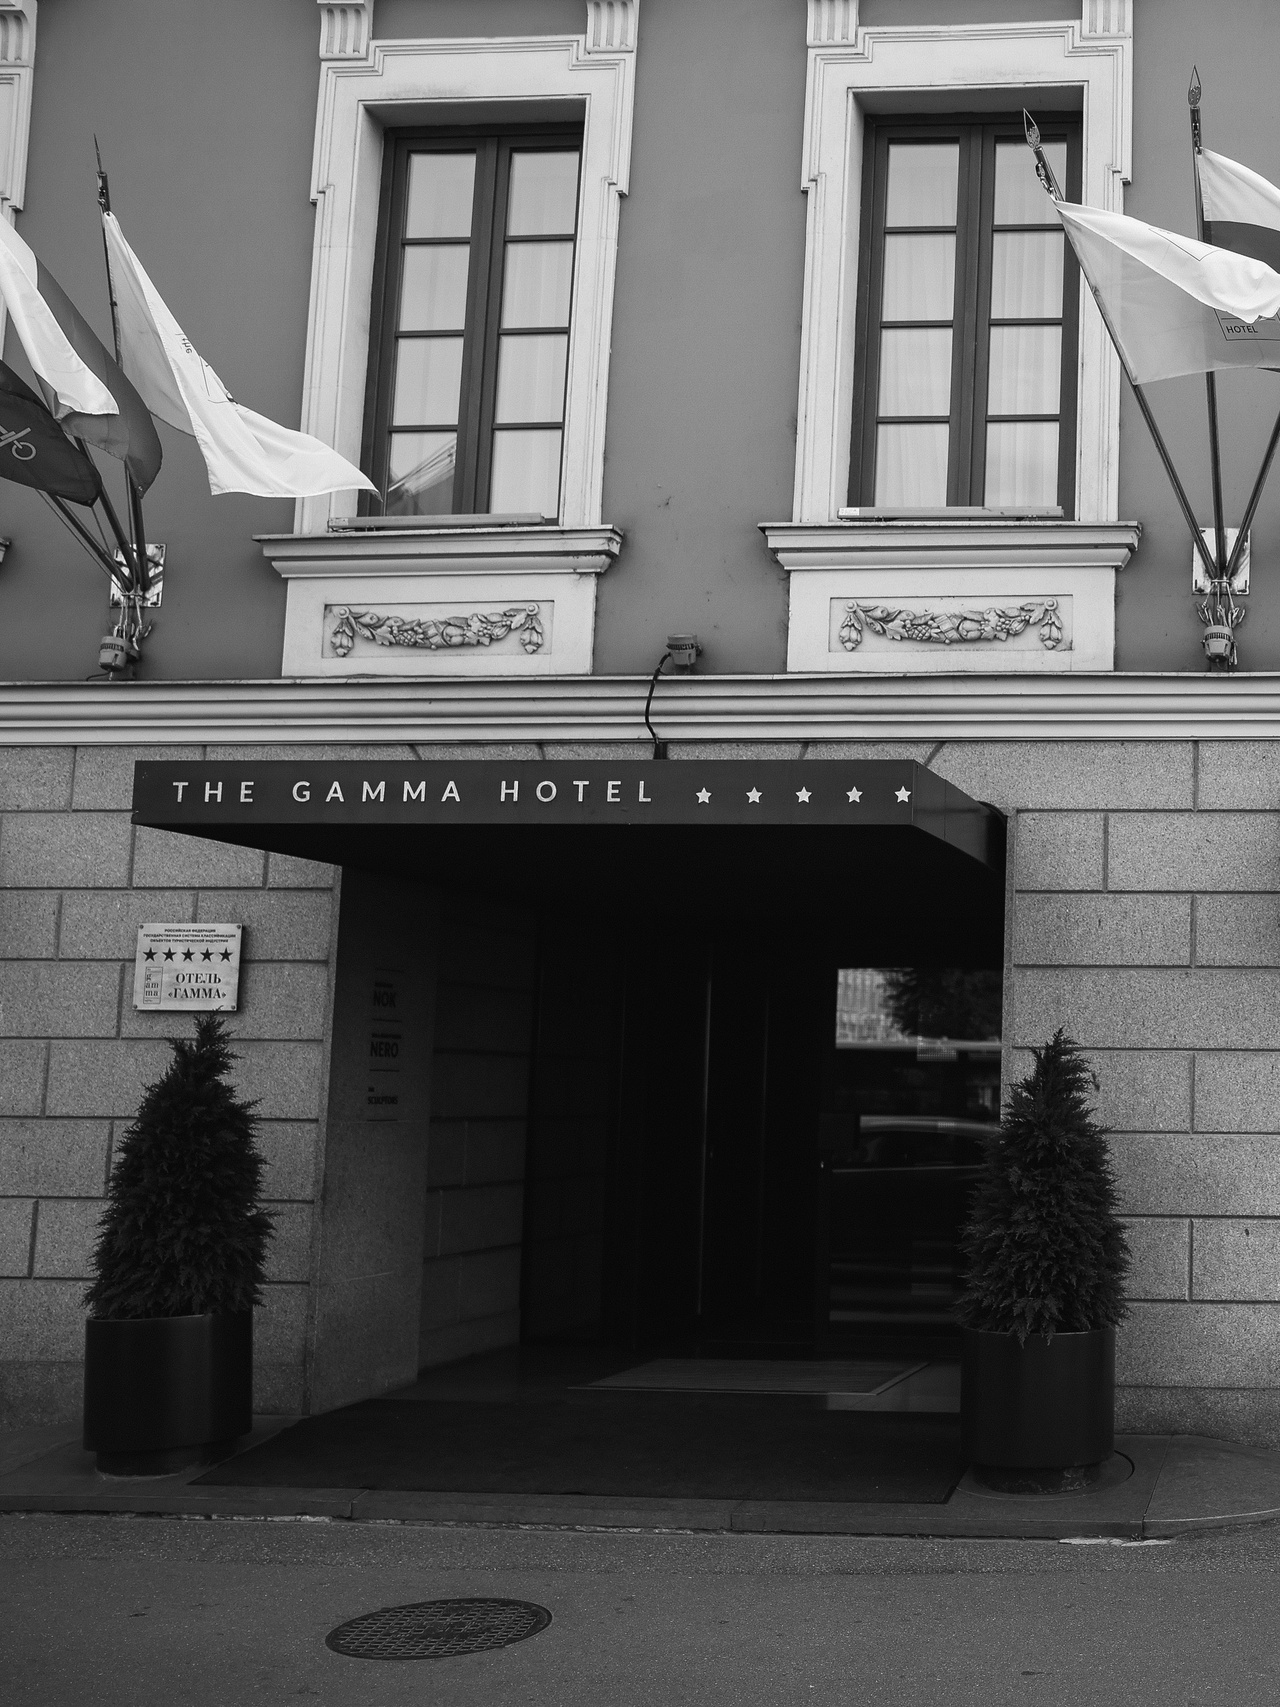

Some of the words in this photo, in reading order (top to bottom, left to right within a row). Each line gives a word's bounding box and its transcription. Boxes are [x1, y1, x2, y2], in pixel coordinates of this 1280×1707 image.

[1226, 325, 1258, 333] HOTEL
[172, 781, 255, 803] THE
[292, 780, 461, 803] GAMMA
[500, 780, 652, 803] HOTEL
[175, 973, 222, 984] ОТЕЛЬ
[168, 987, 227, 999] «ГАММА»
[370, 1041, 399, 1058] NERO
